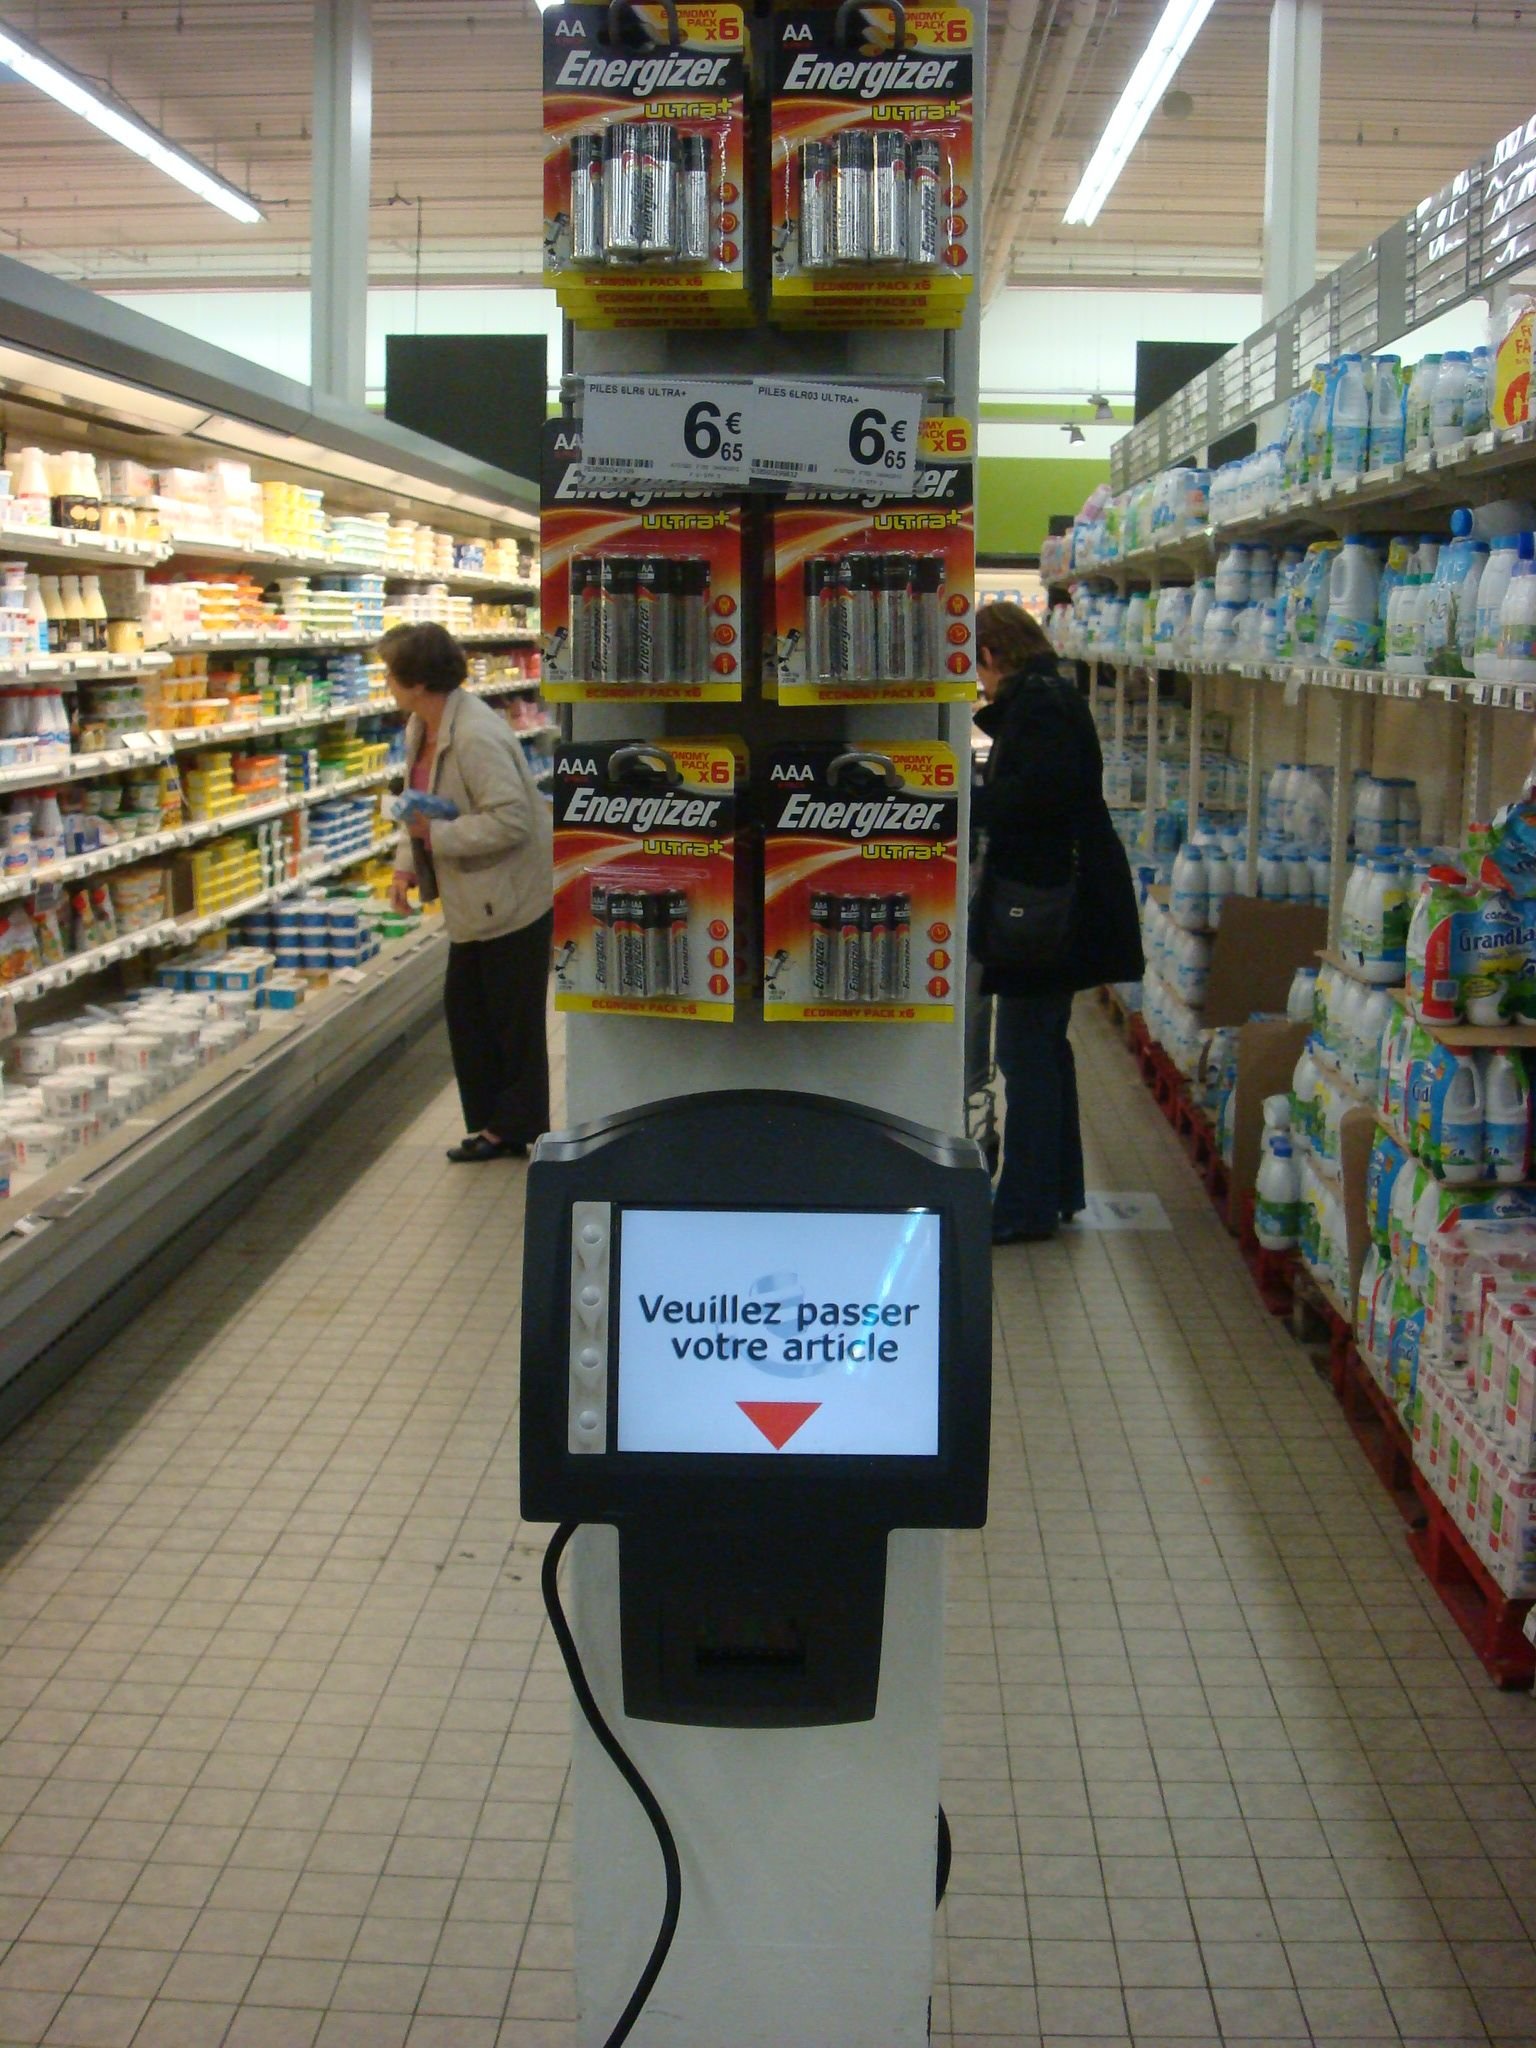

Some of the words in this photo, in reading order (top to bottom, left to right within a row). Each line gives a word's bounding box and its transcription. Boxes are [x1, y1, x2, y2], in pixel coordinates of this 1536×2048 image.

[555, 20, 586, 37] AA
[688, 18, 717, 26] PACK
[915, 20, 944, 29] PACK
[782, 24, 813, 41] AA
[556, 50, 730, 96] Energizer
[783, 54, 958, 98] Energizer
[590, 384, 618, 394] PILES
[648, 387, 686, 398] ULTRA+
[758, 386, 786, 397] PILES
[789, 389, 818, 400] 6LR03
[821, 393, 860, 404] ULTRA+
[684, 401, 721, 458] 6
[849, 408, 886, 466] 6
[721, 442, 743, 462] 65
[884, 450, 906, 469] 65
[557, 759, 598, 776] AAA
[682, 761, 709, 770] PACK
[770, 765, 814, 781] AAA
[904, 764, 932, 773] PACK
[563, 788, 720, 833] Energizer
[777, 794, 945, 838] Energizer
[650, 1003, 678, 1013] PACK
[864, 1008, 895, 1018] PACK
[639, 1294, 781, 1324] Veuillez
[797, 1302, 920, 1332] passer
[672, 1333, 768, 1361] votre
[783, 1333, 898, 1362] article
